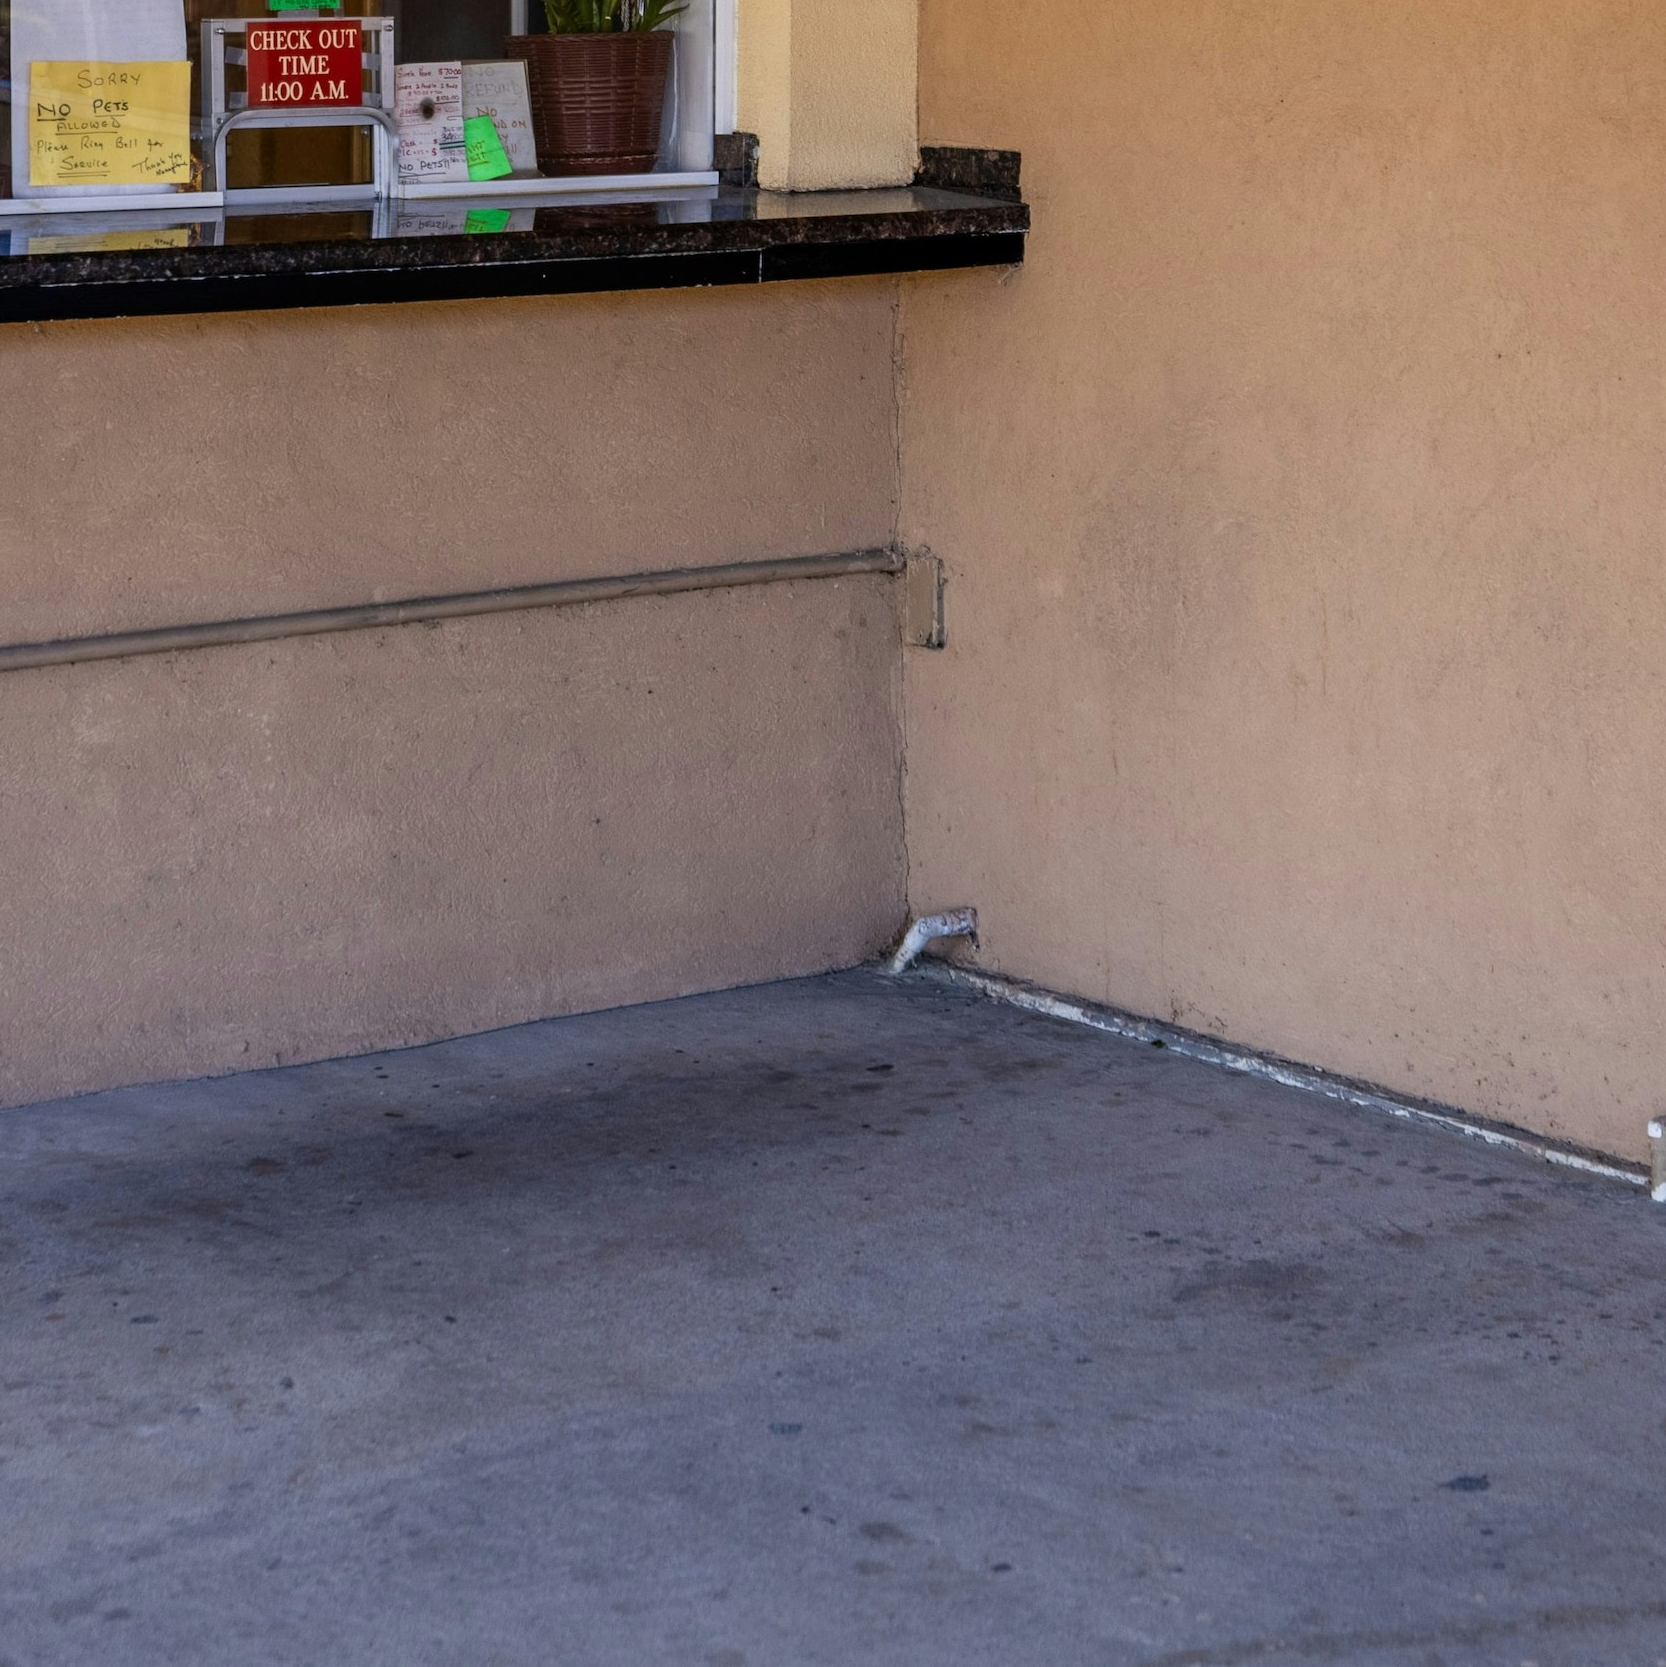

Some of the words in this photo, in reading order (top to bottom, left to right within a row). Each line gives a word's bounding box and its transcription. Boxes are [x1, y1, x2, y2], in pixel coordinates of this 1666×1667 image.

[250, 30, 313, 50] CHECK
[318, 29, 357, 49] OUT
[278, 55, 330, 75] TIME
[260, 81, 304, 101] 11:00
[310, 80, 349, 100] A.M.
[37, 103, 71, 117] NO
[477, 106, 498, 117] NO
[57, 117, 121, 132] ALLOWED
[81, 136, 103, 151] Ring
[116, 136, 137, 150] Bell
[399, 164, 414, 172] NO
